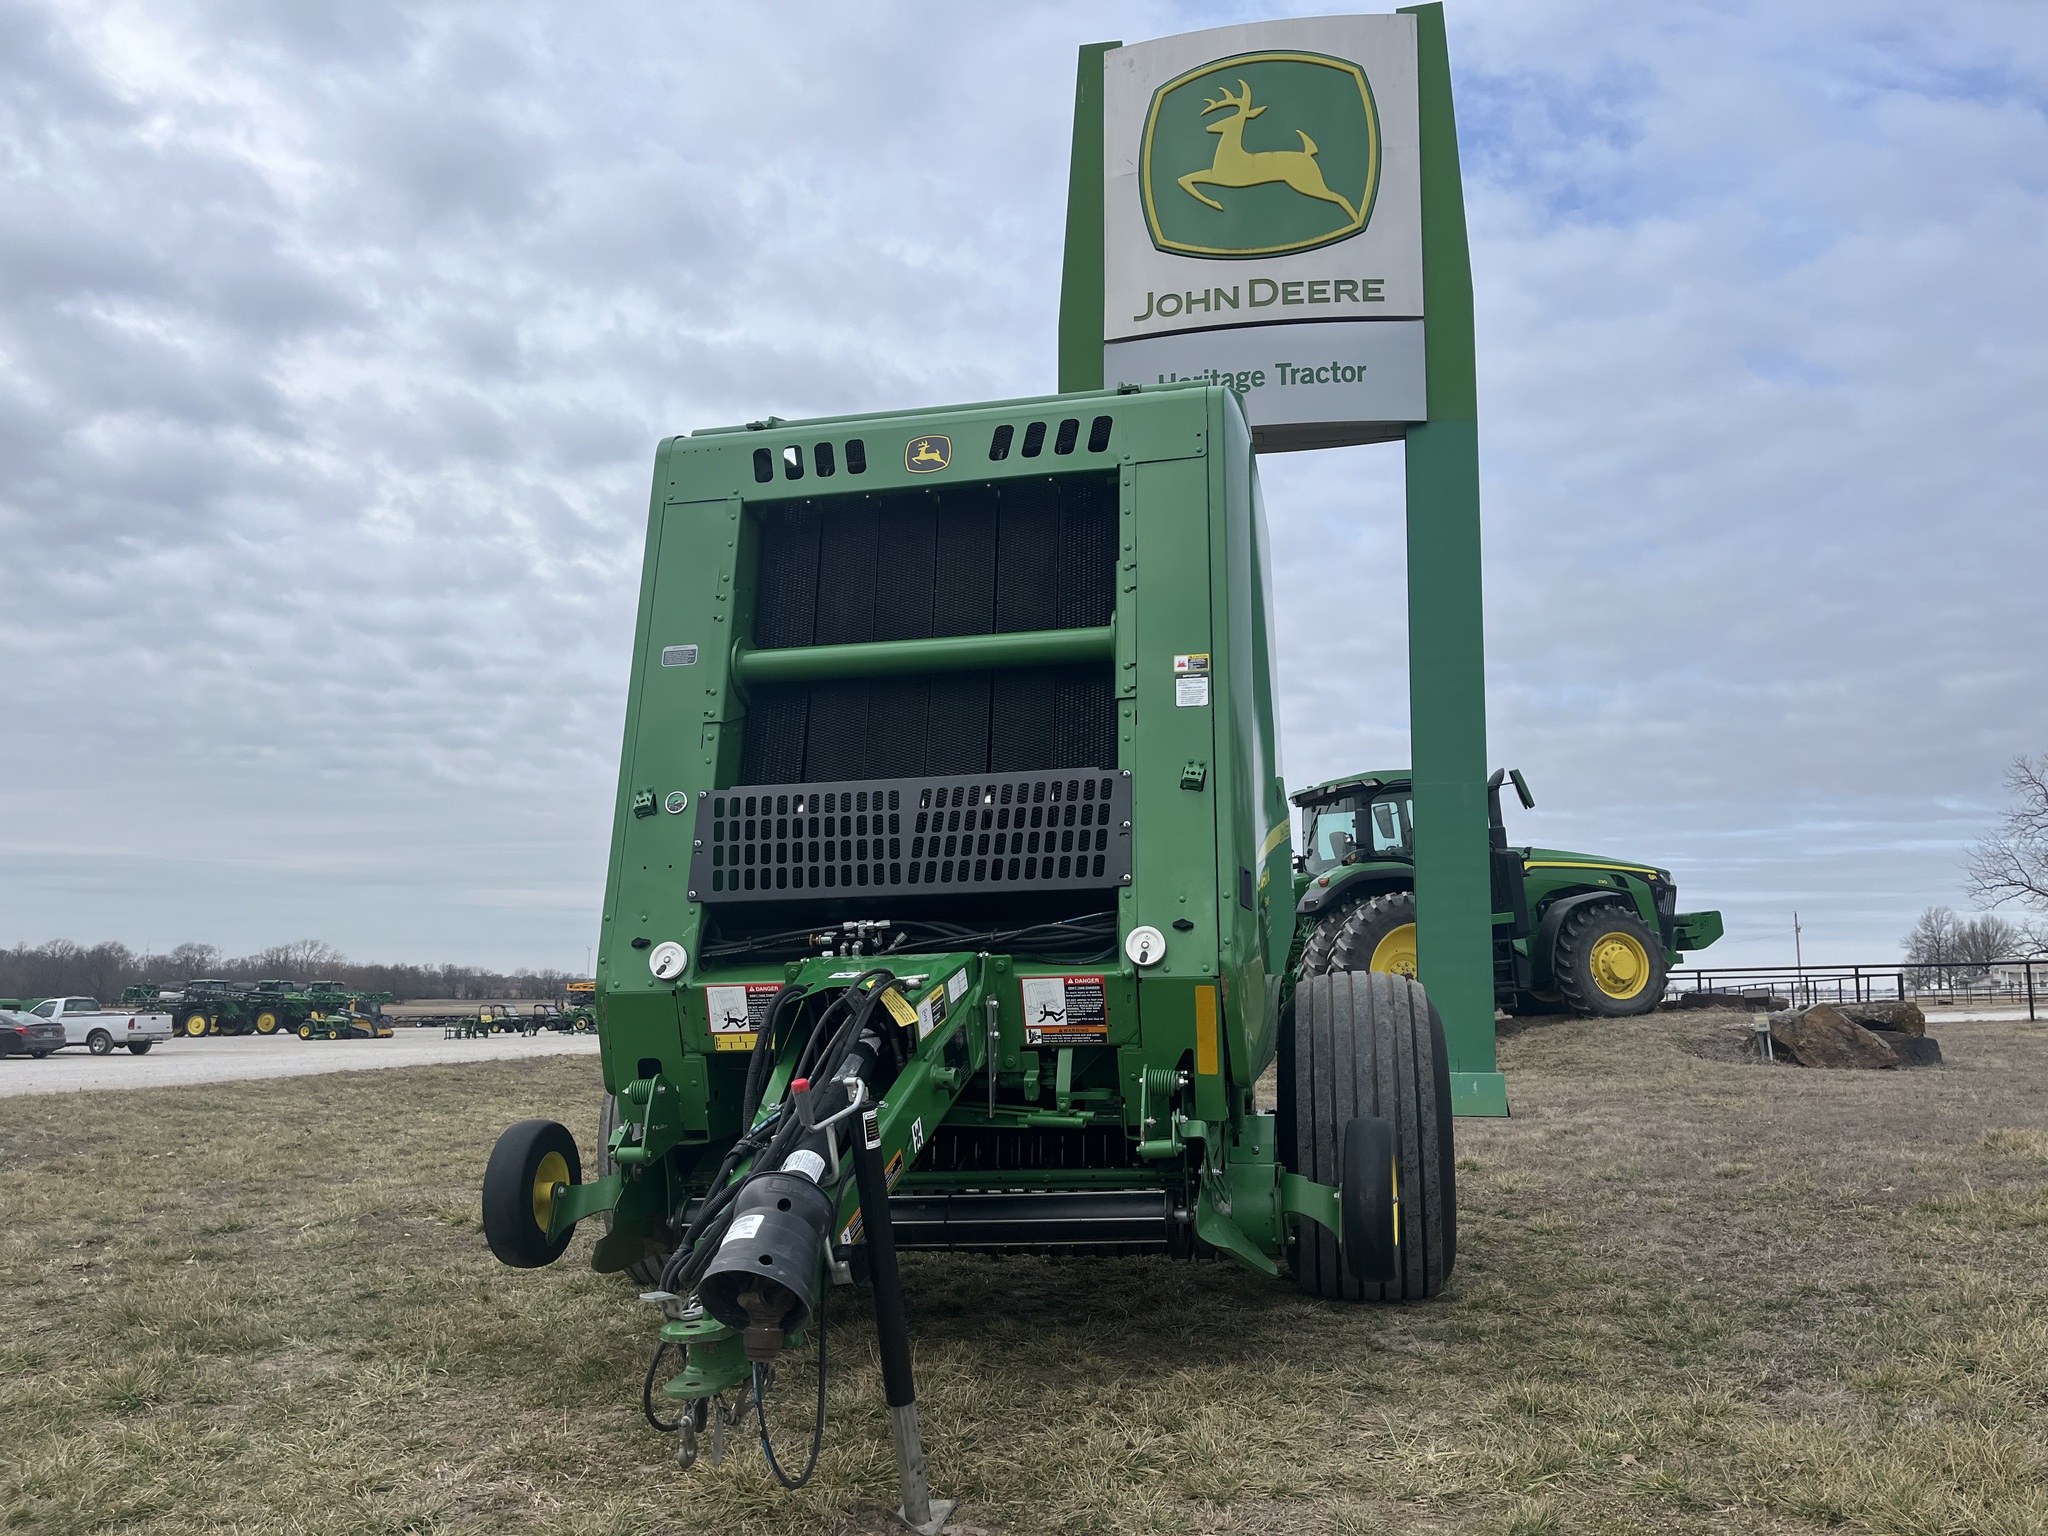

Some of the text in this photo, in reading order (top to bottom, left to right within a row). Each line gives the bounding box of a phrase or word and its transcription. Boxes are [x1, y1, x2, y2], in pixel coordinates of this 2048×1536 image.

[1133, 278, 1385, 321] JOHN DEERE
[1274, 361, 1367, 386] Tractor
